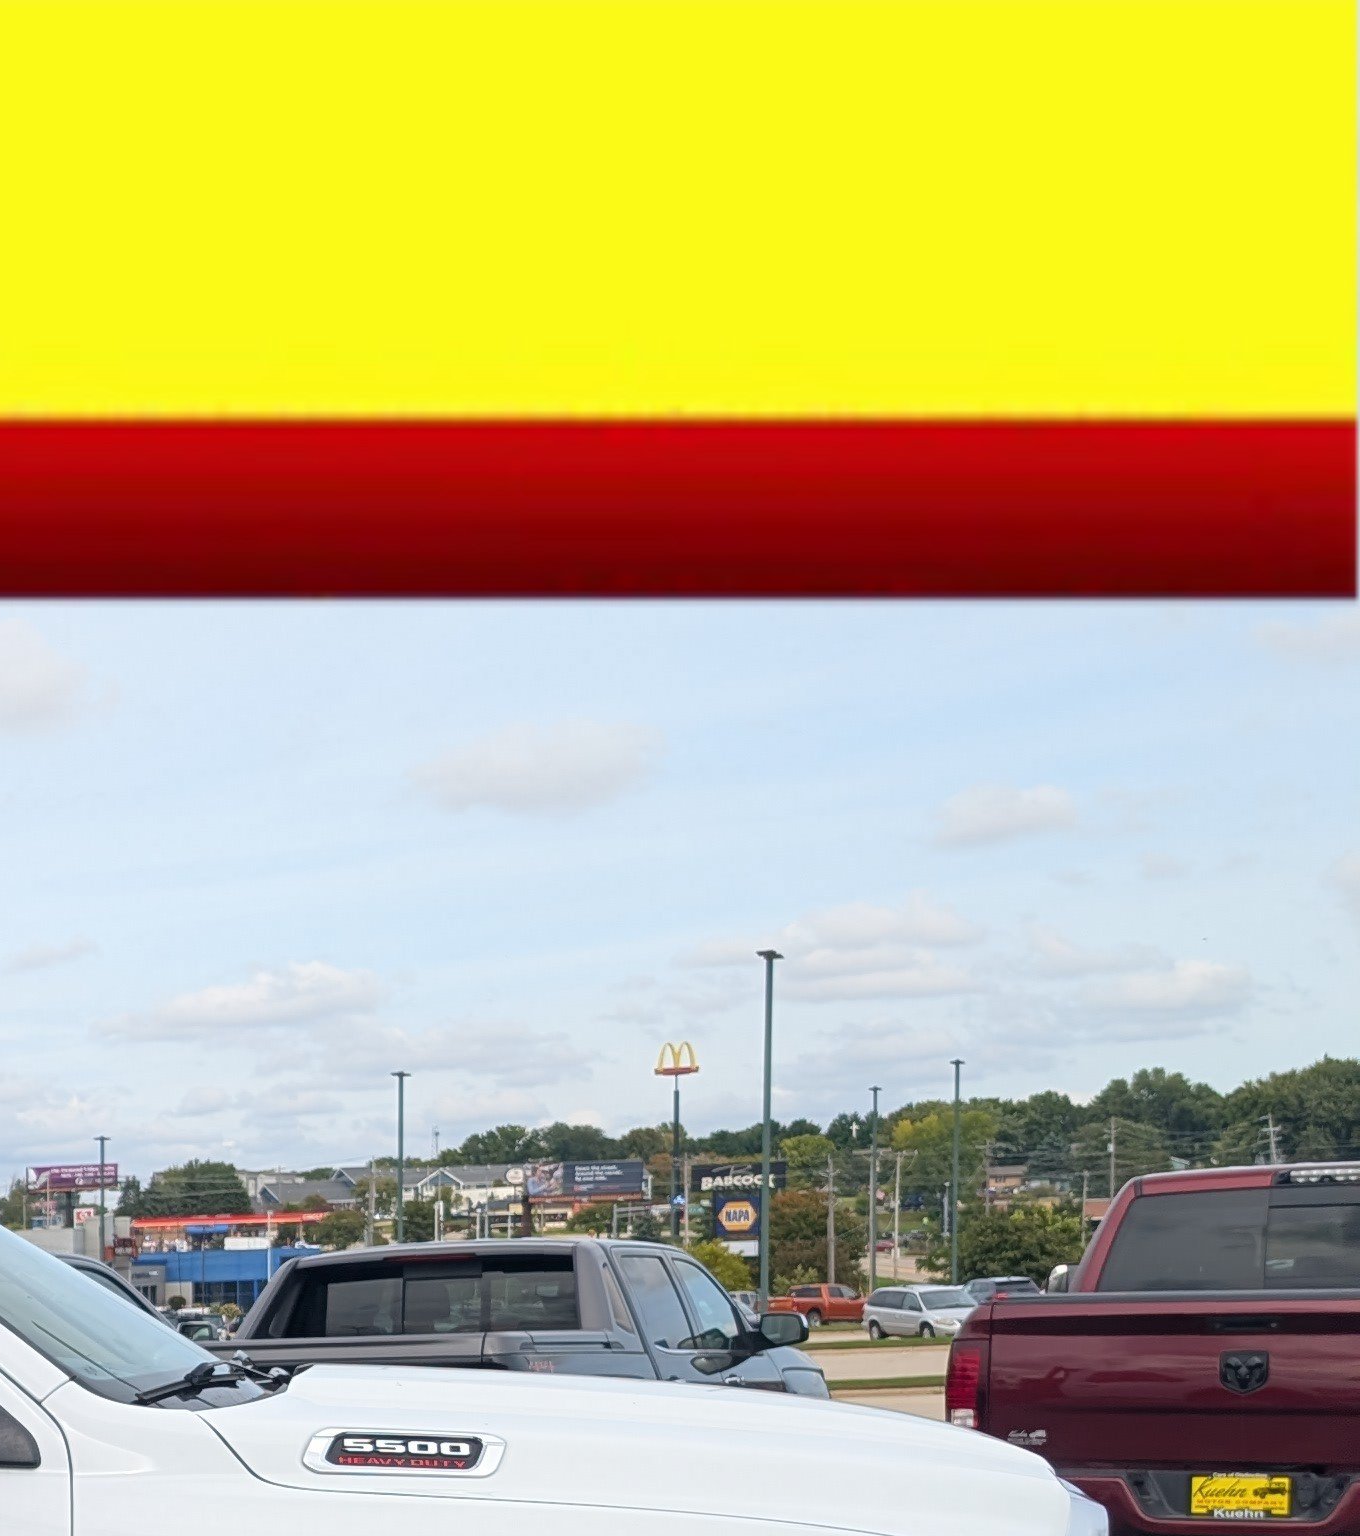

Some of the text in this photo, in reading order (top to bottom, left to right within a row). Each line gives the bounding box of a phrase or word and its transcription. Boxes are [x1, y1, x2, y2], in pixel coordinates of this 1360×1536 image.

[725, 1209, 750, 1222] NAPA
[341, 1437, 471, 1456] 5500
[338, 1456, 467, 1469] HEAVY DUTY
[1192, 1476, 1248, 1499] Kuehn
[1213, 1508, 1264, 1519] Kuehn
